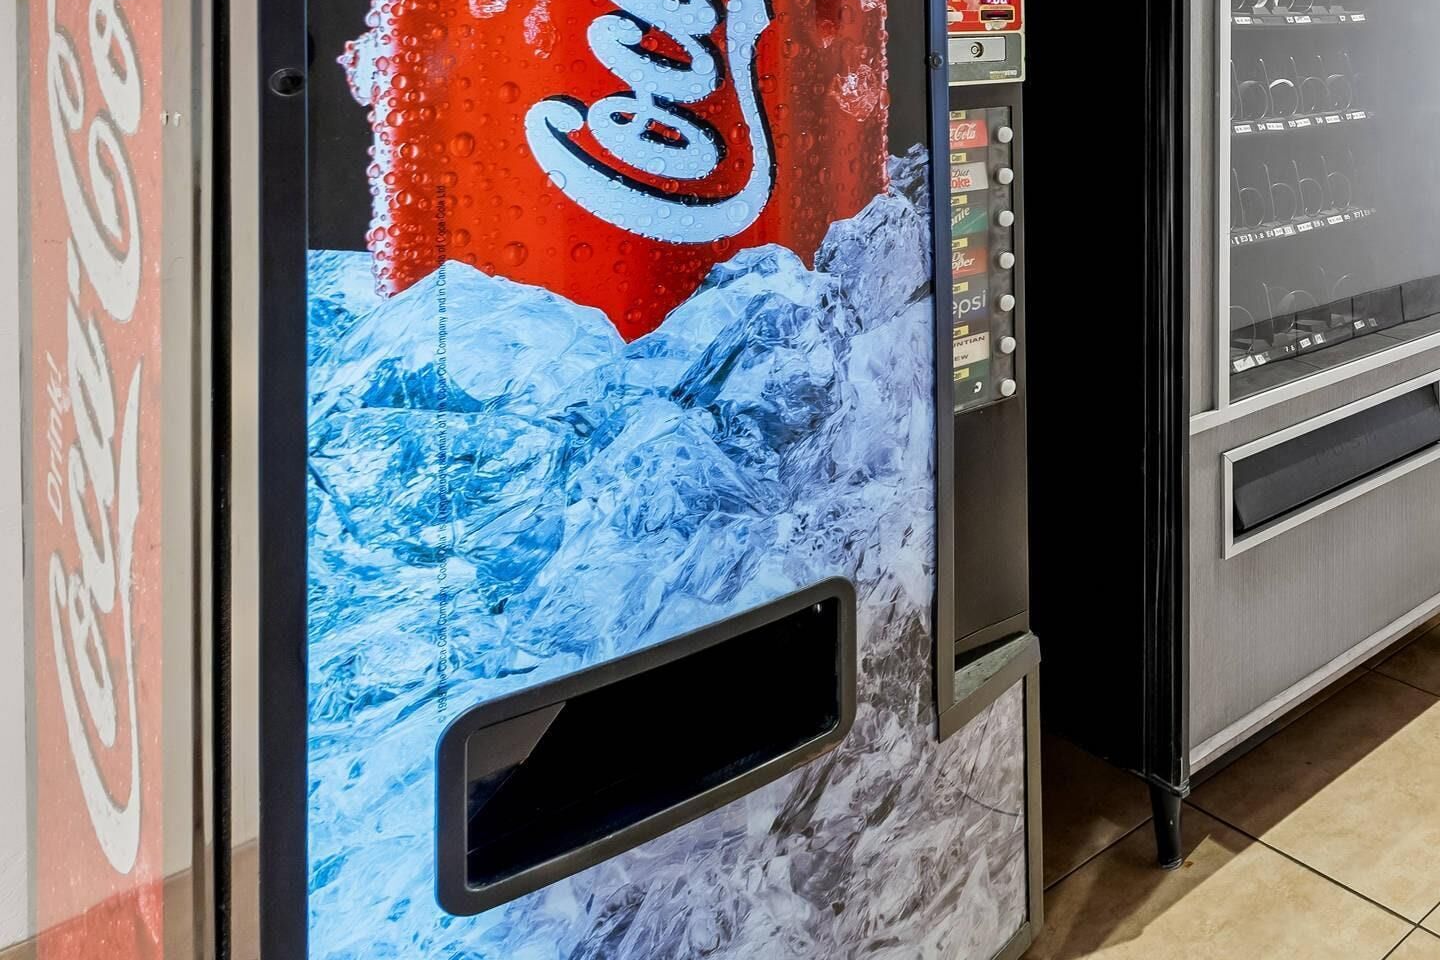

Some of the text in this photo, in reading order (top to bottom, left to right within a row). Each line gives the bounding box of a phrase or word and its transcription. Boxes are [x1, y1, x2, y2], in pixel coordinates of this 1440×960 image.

[951, 178, 971, 189] oke
[951, 207, 970, 226] rite
[437, 298, 446, 313] and
[953, 289, 987, 319] epsi
[954, 354, 968, 362] EW
